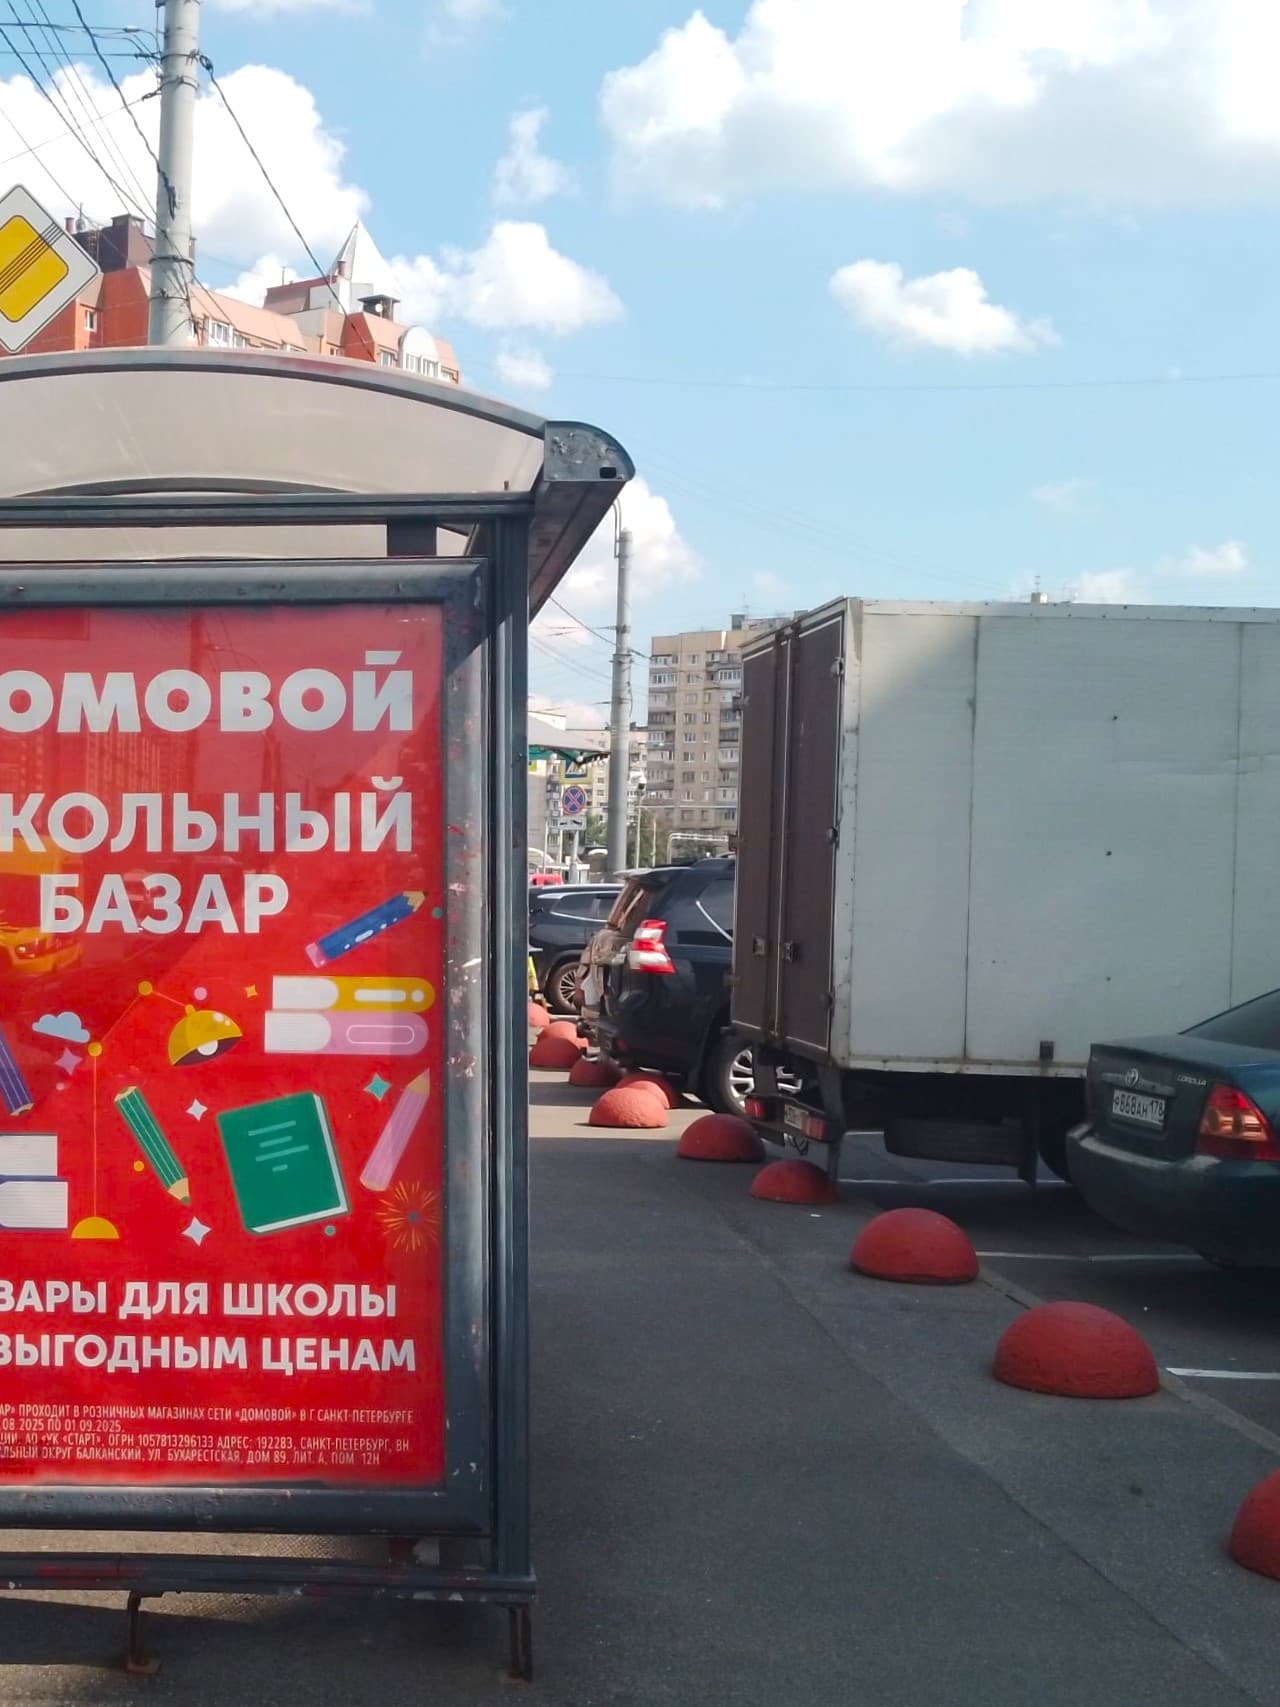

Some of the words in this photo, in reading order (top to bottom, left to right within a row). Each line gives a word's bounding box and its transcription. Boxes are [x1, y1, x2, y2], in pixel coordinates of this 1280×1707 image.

[39, 873, 289, 934] БАЗАР
[118, 1281, 209, 1319] ДЛЯ
[223, 1283, 397, 1318] ШКОЛЫ
[261, 1337, 416, 1376] ЦЕНАМ
[20, 1404, 70, 1419] ПРОХОДИТ
[73, 1406, 80, 1418] В
[83, 1405, 145, 1419] РОЗНИЧНЫХ
[148, 1407, 204, 1420] МАГАЗИНАХ
[208, 1408, 232, 1421] СЕТИ
[235, 1406, 297, 1422] «ДОМОВОЙ»
[300, 1409, 306, 1422] В
[317, 1409, 414, 1424] САНКТ-ПЕТЕРБУРГЕ
[48, 1418, 62, 1431] ПО
[25, 1432, 38, 1445] АО
[108, 1434, 135, 1447] ОГРН
[137, 1434, 214, 1448] 1057813296133
[42, 1446, 73, 1460] ОКРУГ
[247, 1450, 270, 1464] ДОМ
